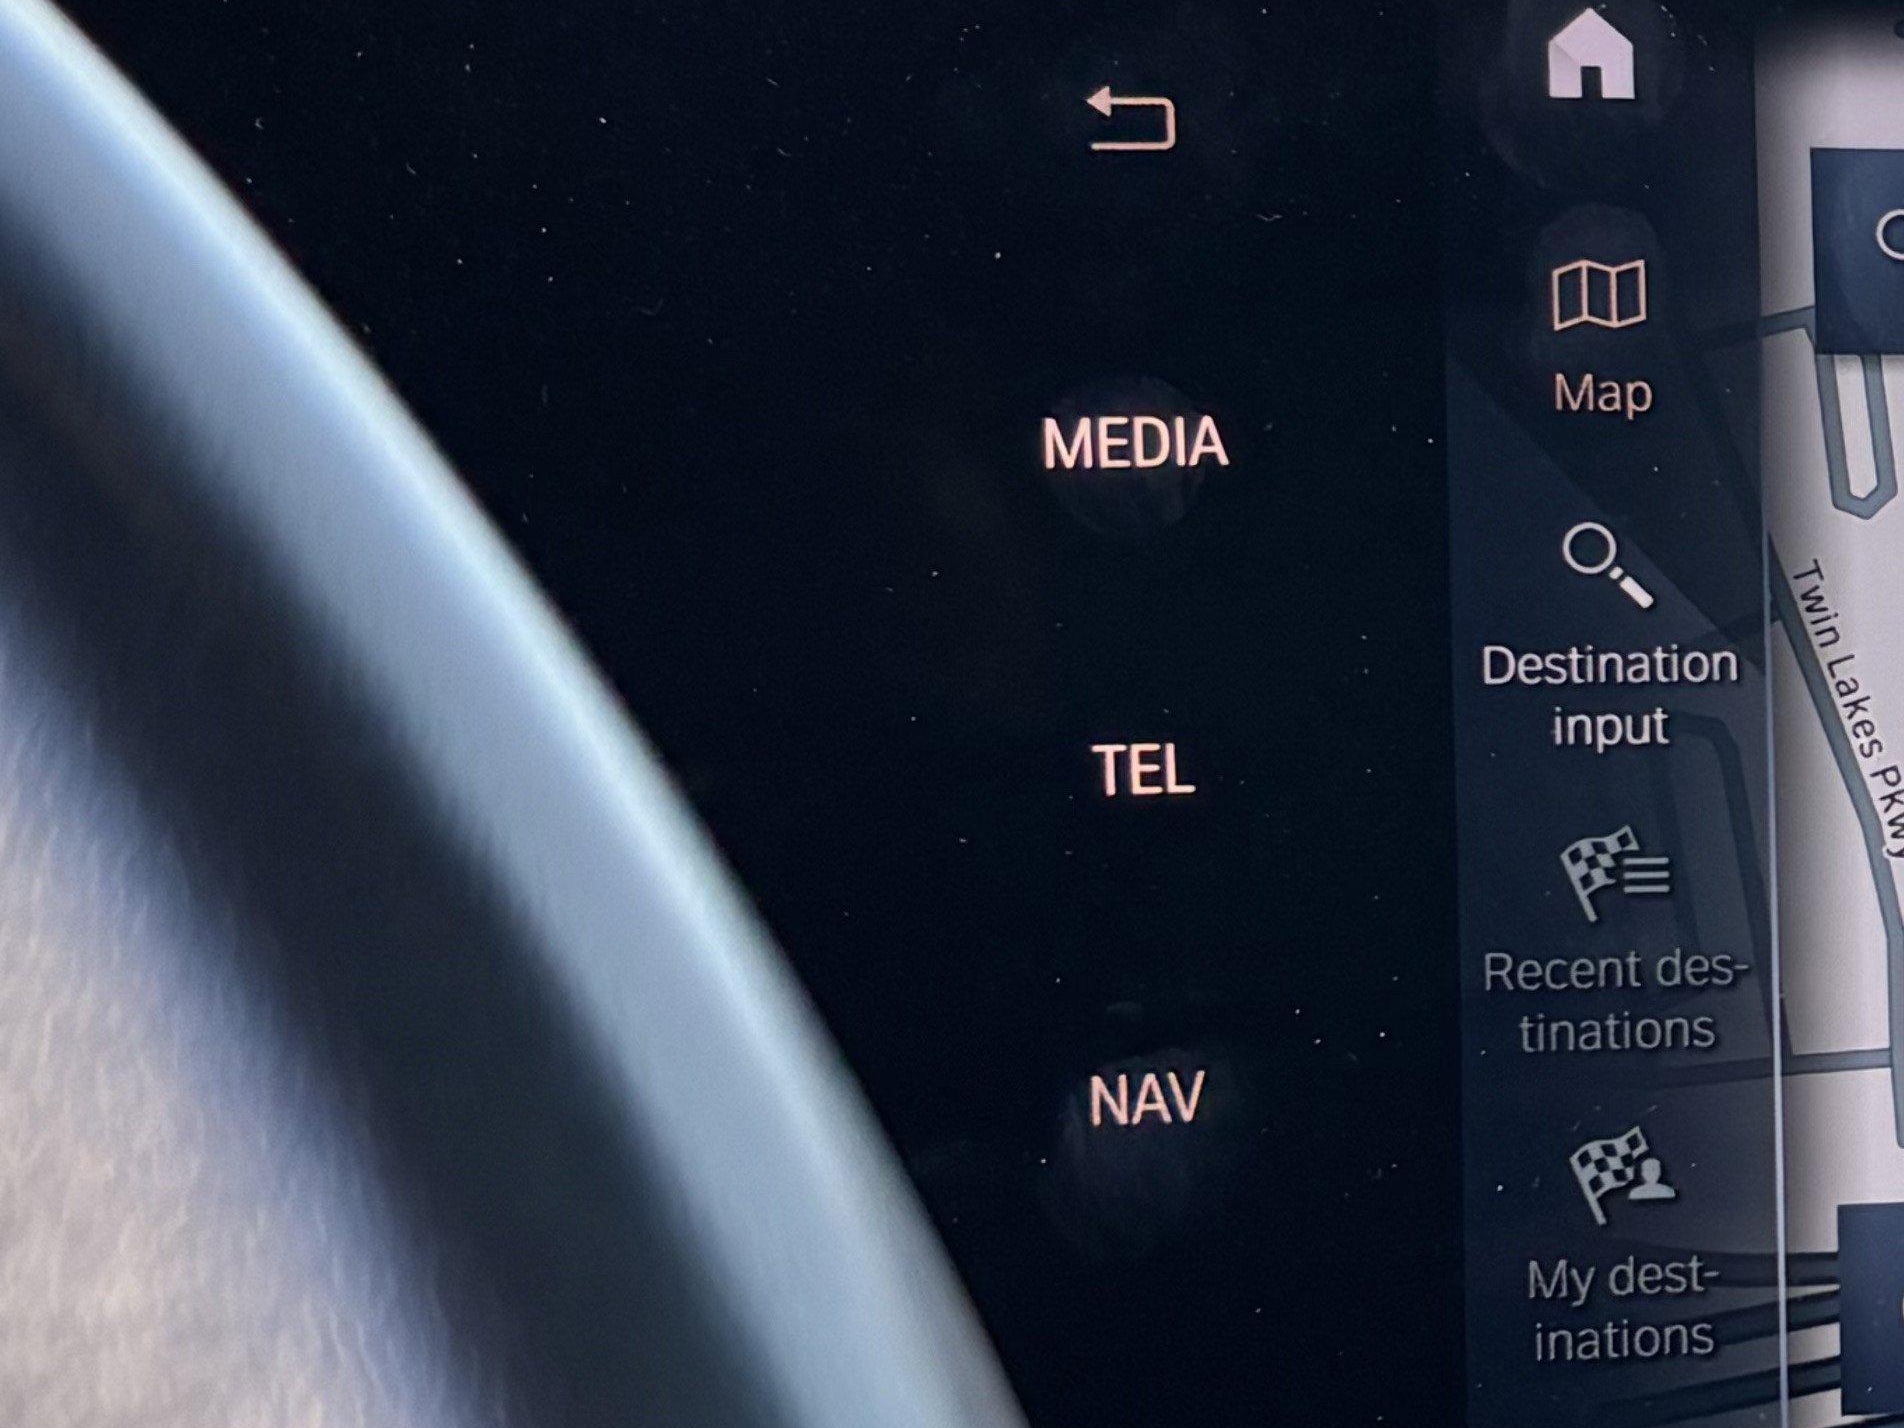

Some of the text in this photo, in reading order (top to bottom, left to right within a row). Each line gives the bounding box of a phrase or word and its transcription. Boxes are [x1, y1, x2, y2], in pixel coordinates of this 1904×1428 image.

[1554, 371, 1654, 421] Map
[1043, 413, 1231, 470] MEDIA
[1482, 642, 1739, 686] Destination
[1793, 558, 1840, 648] Twin
[1826, 653, 1884, 759] Lakes
[1553, 705, 1671, 754] input
[1090, 741, 1197, 797] TEL
[1483, 946, 1750, 992] Recent des-
[1518, 1009, 1716, 1054] tinations
[1089, 1069, 1206, 1127] NAV
[1527, 1254, 1721, 1308] My dest-
[1534, 1318, 1715, 1363] inations
